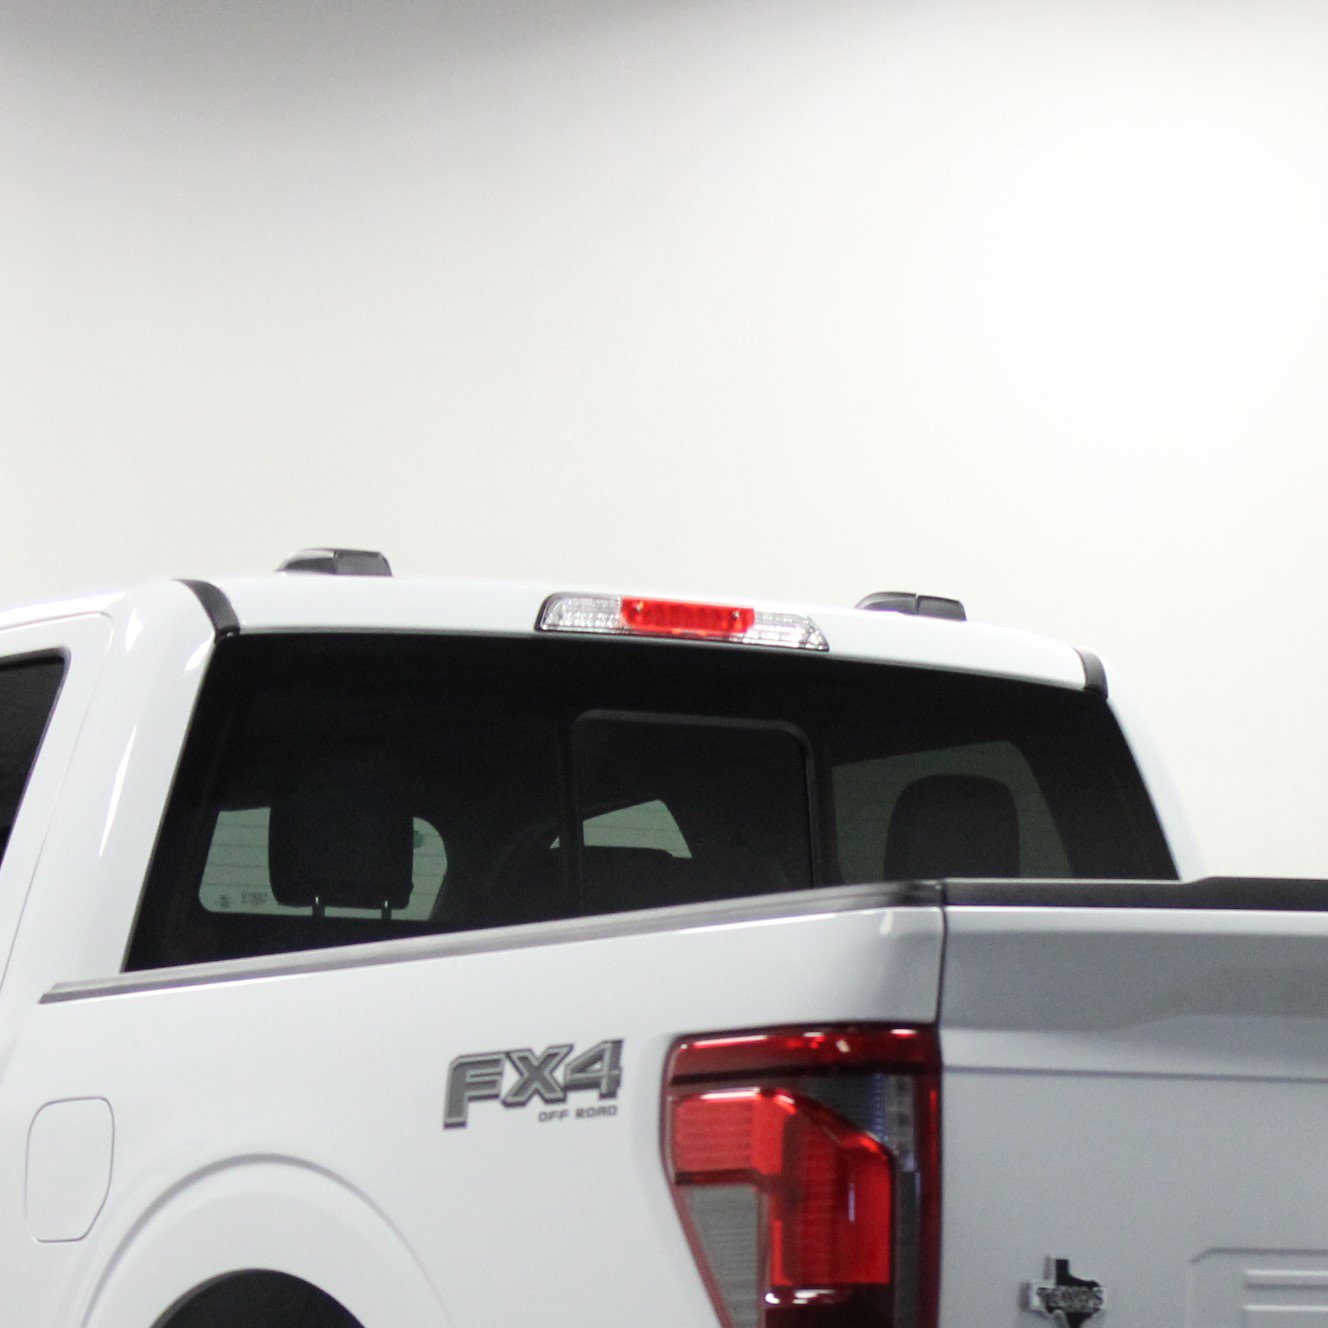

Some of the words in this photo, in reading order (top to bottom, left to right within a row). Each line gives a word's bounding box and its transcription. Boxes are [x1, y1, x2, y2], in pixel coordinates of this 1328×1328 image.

[443, 1038, 624, 1130] FX4
[538, 1109, 569, 1122] OFF
[575, 1105, 618, 1119] ROAD
